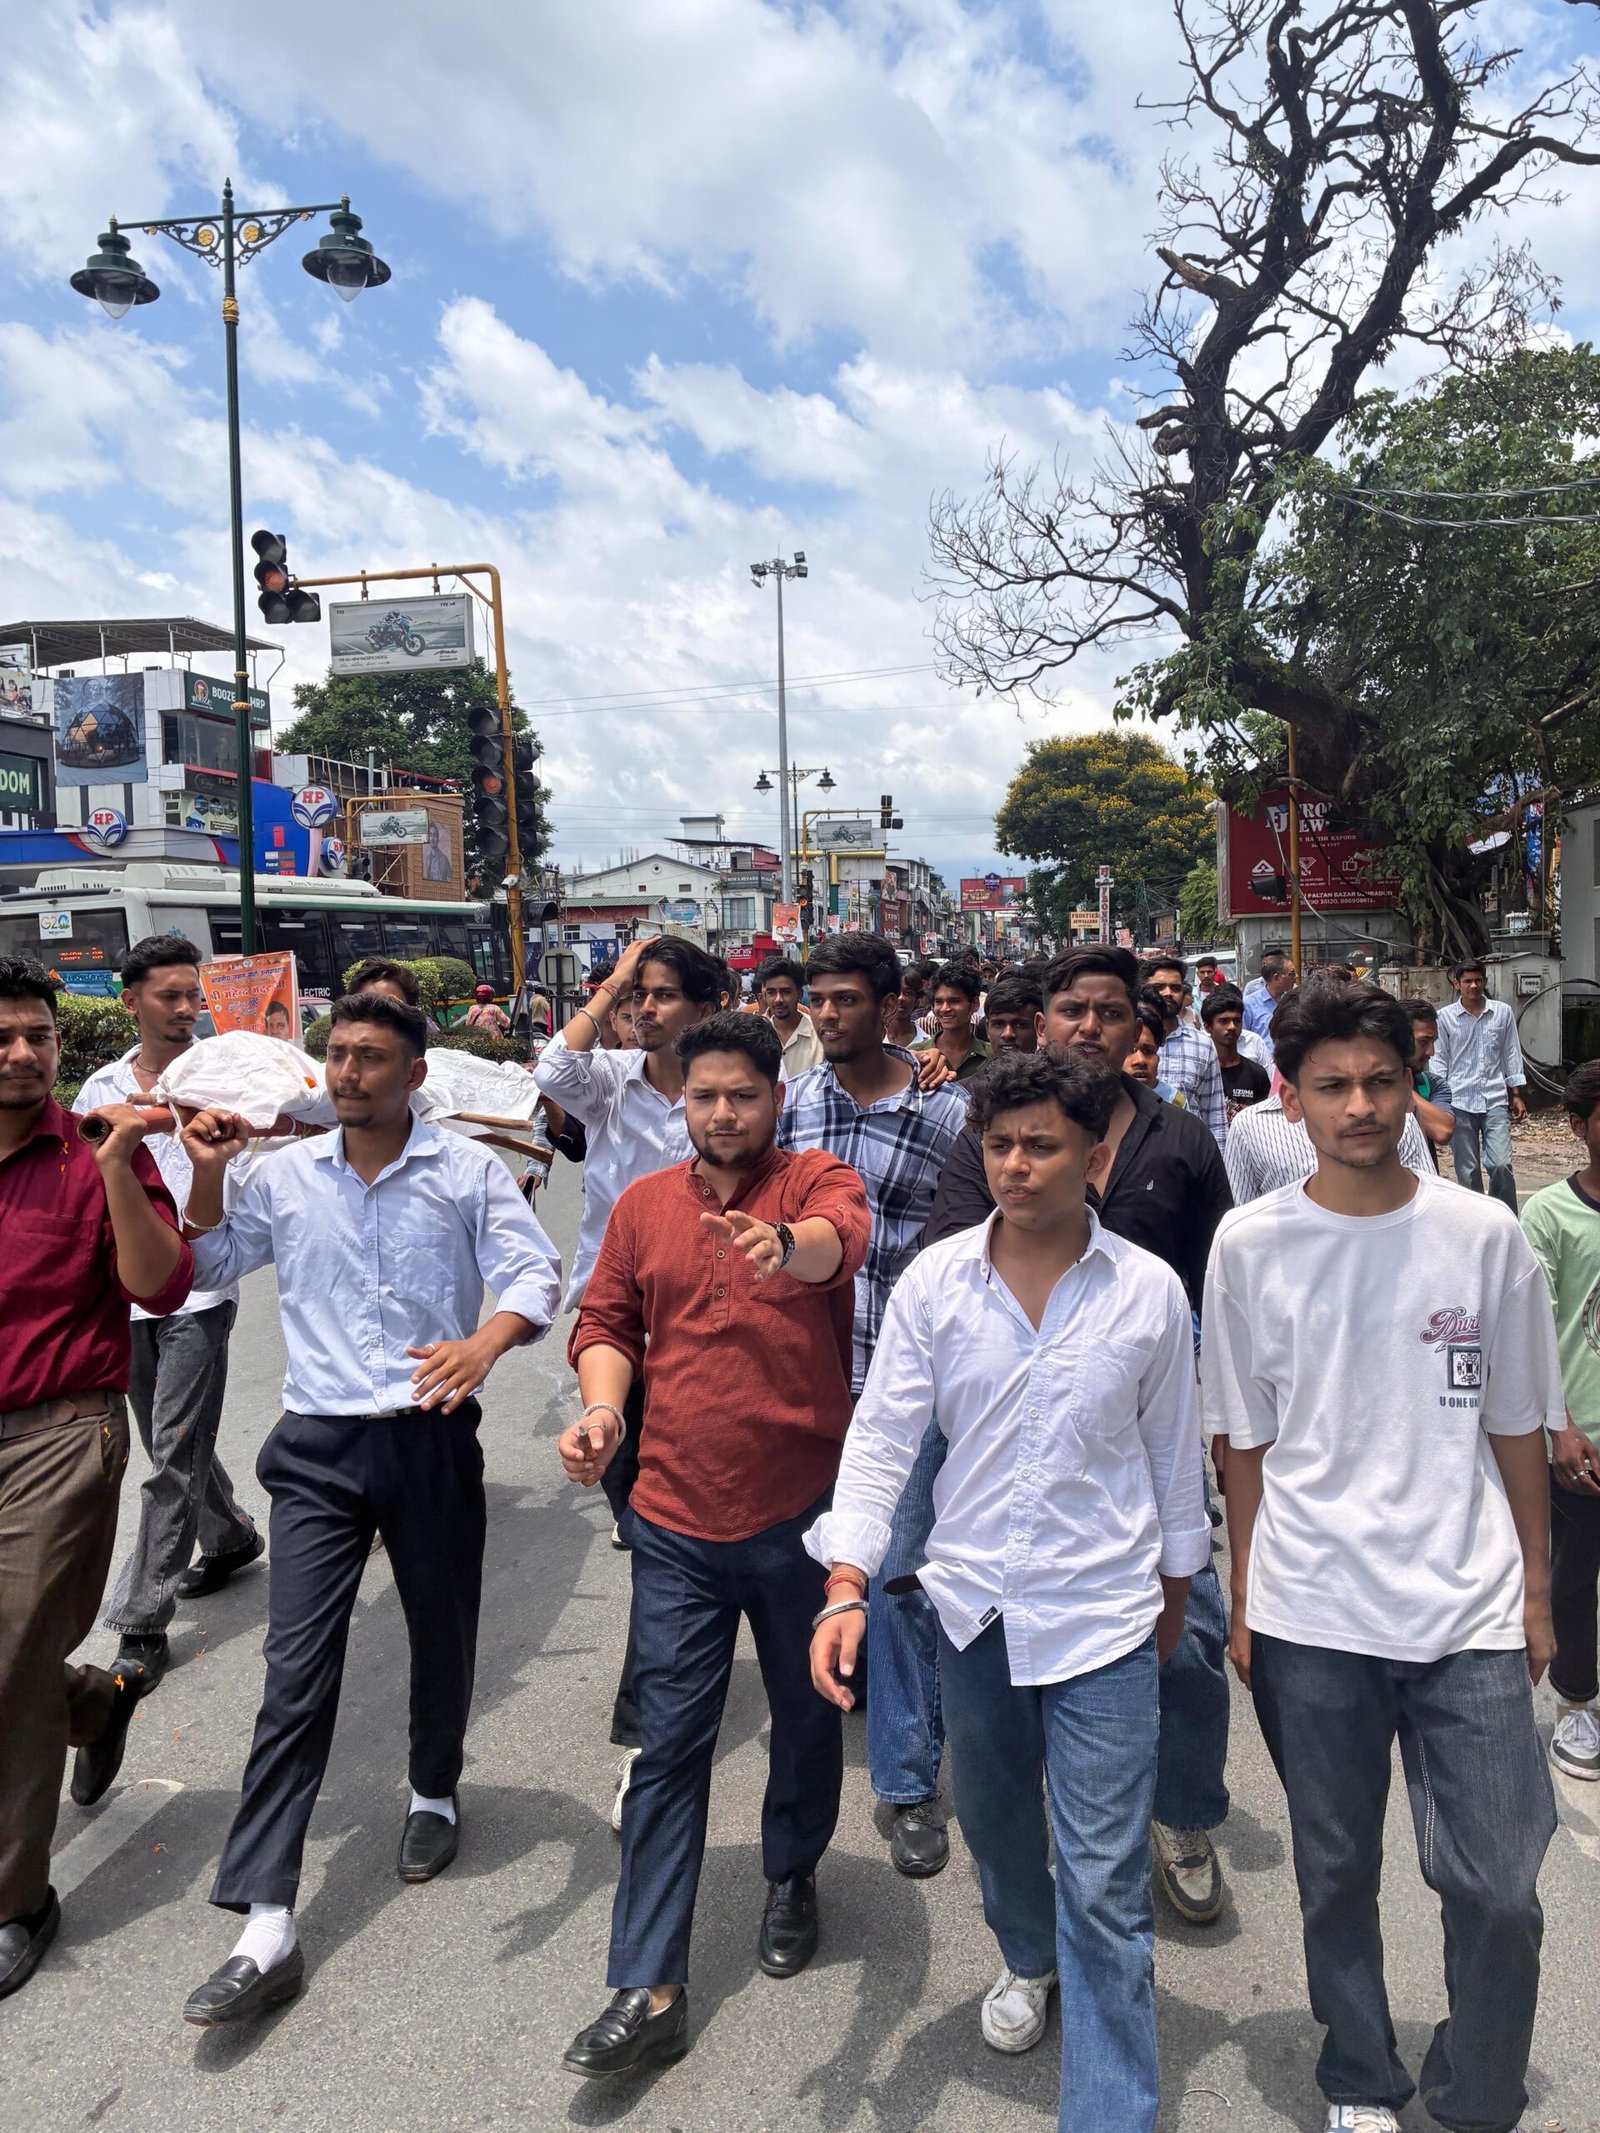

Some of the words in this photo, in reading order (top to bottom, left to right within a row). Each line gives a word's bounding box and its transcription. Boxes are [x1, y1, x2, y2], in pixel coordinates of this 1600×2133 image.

[211, 686, 236, 702] BOOZE
[249, 696, 266, 710] MRP
[302, 791, 325, 804] HP
[94, 813, 115, 825] HP
[1307, 891, 1333, 899] PALTAN
[41, 914, 70, 929] G20
[299, 987, 331, 998] LECTRIC
[1439, 1396, 1446, 1406] U
[1448, 1397, 1468, 1408] ONE
